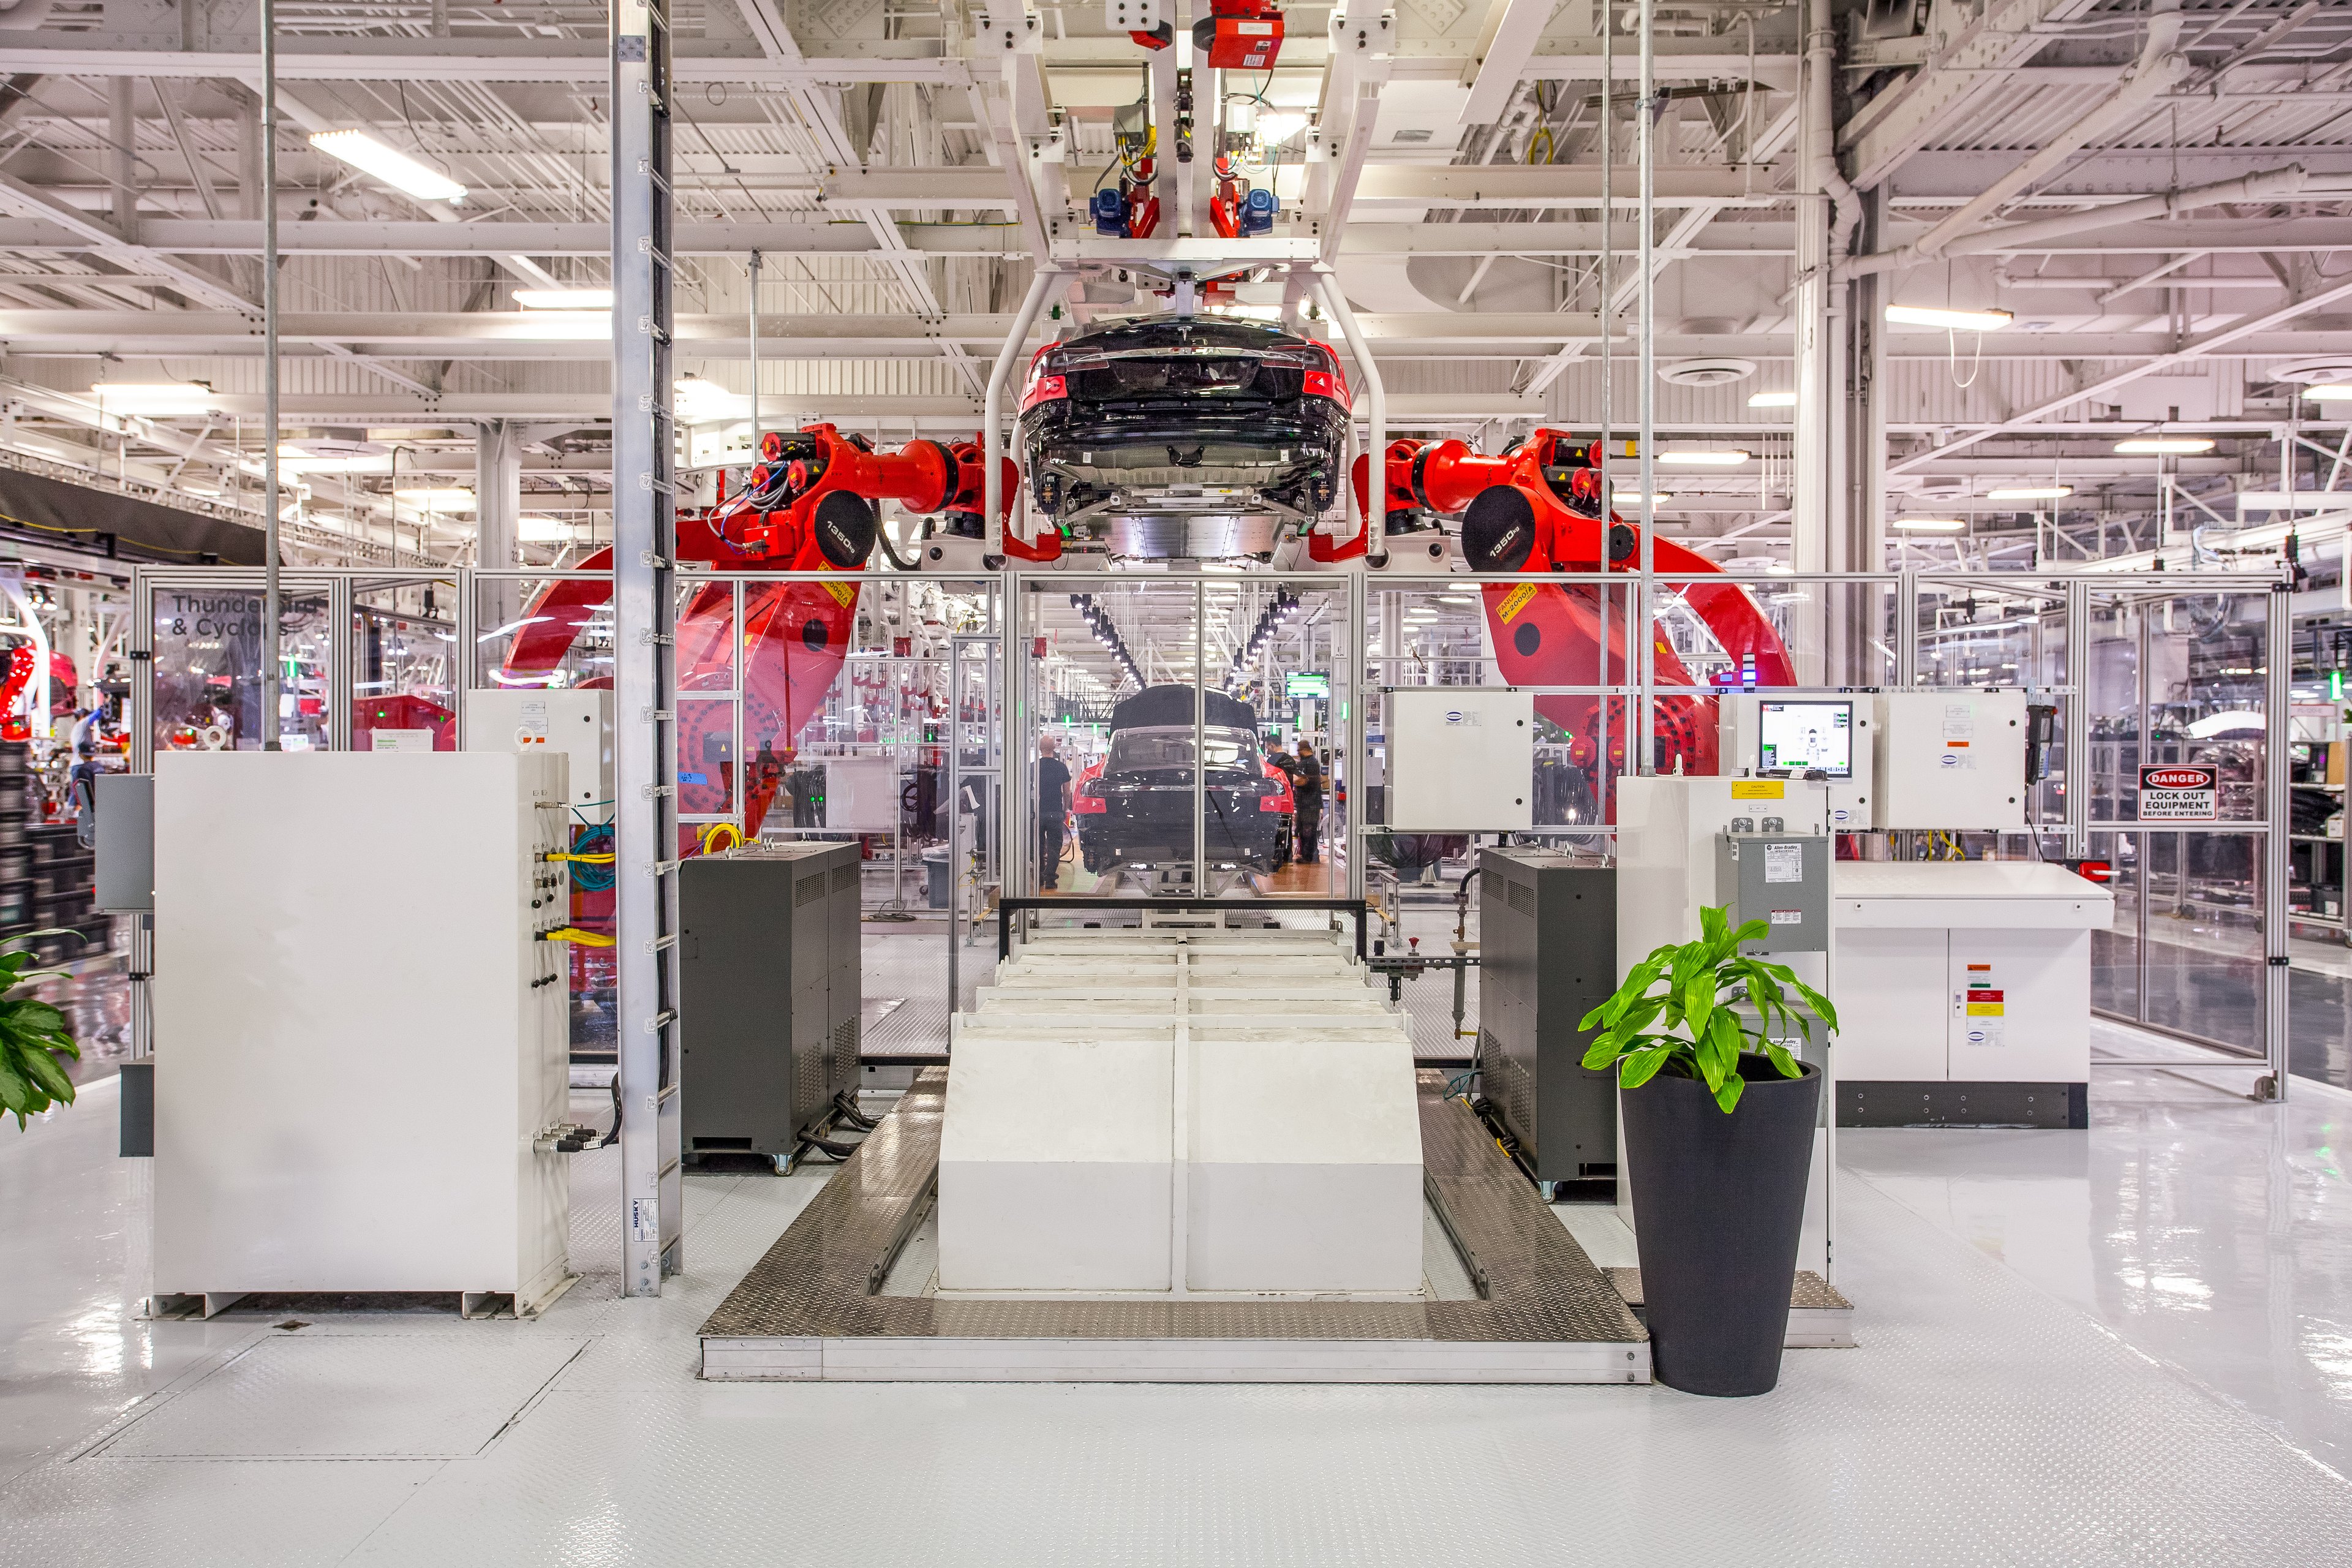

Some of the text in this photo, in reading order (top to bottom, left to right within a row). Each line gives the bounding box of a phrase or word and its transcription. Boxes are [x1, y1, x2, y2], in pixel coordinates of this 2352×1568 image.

[511, 551, 518, 563] 32
[1497, 590, 1518, 614] FANUC
[172, 618, 288, 639] & Cyclos
[2151, 774, 2204, 783] DANGER
